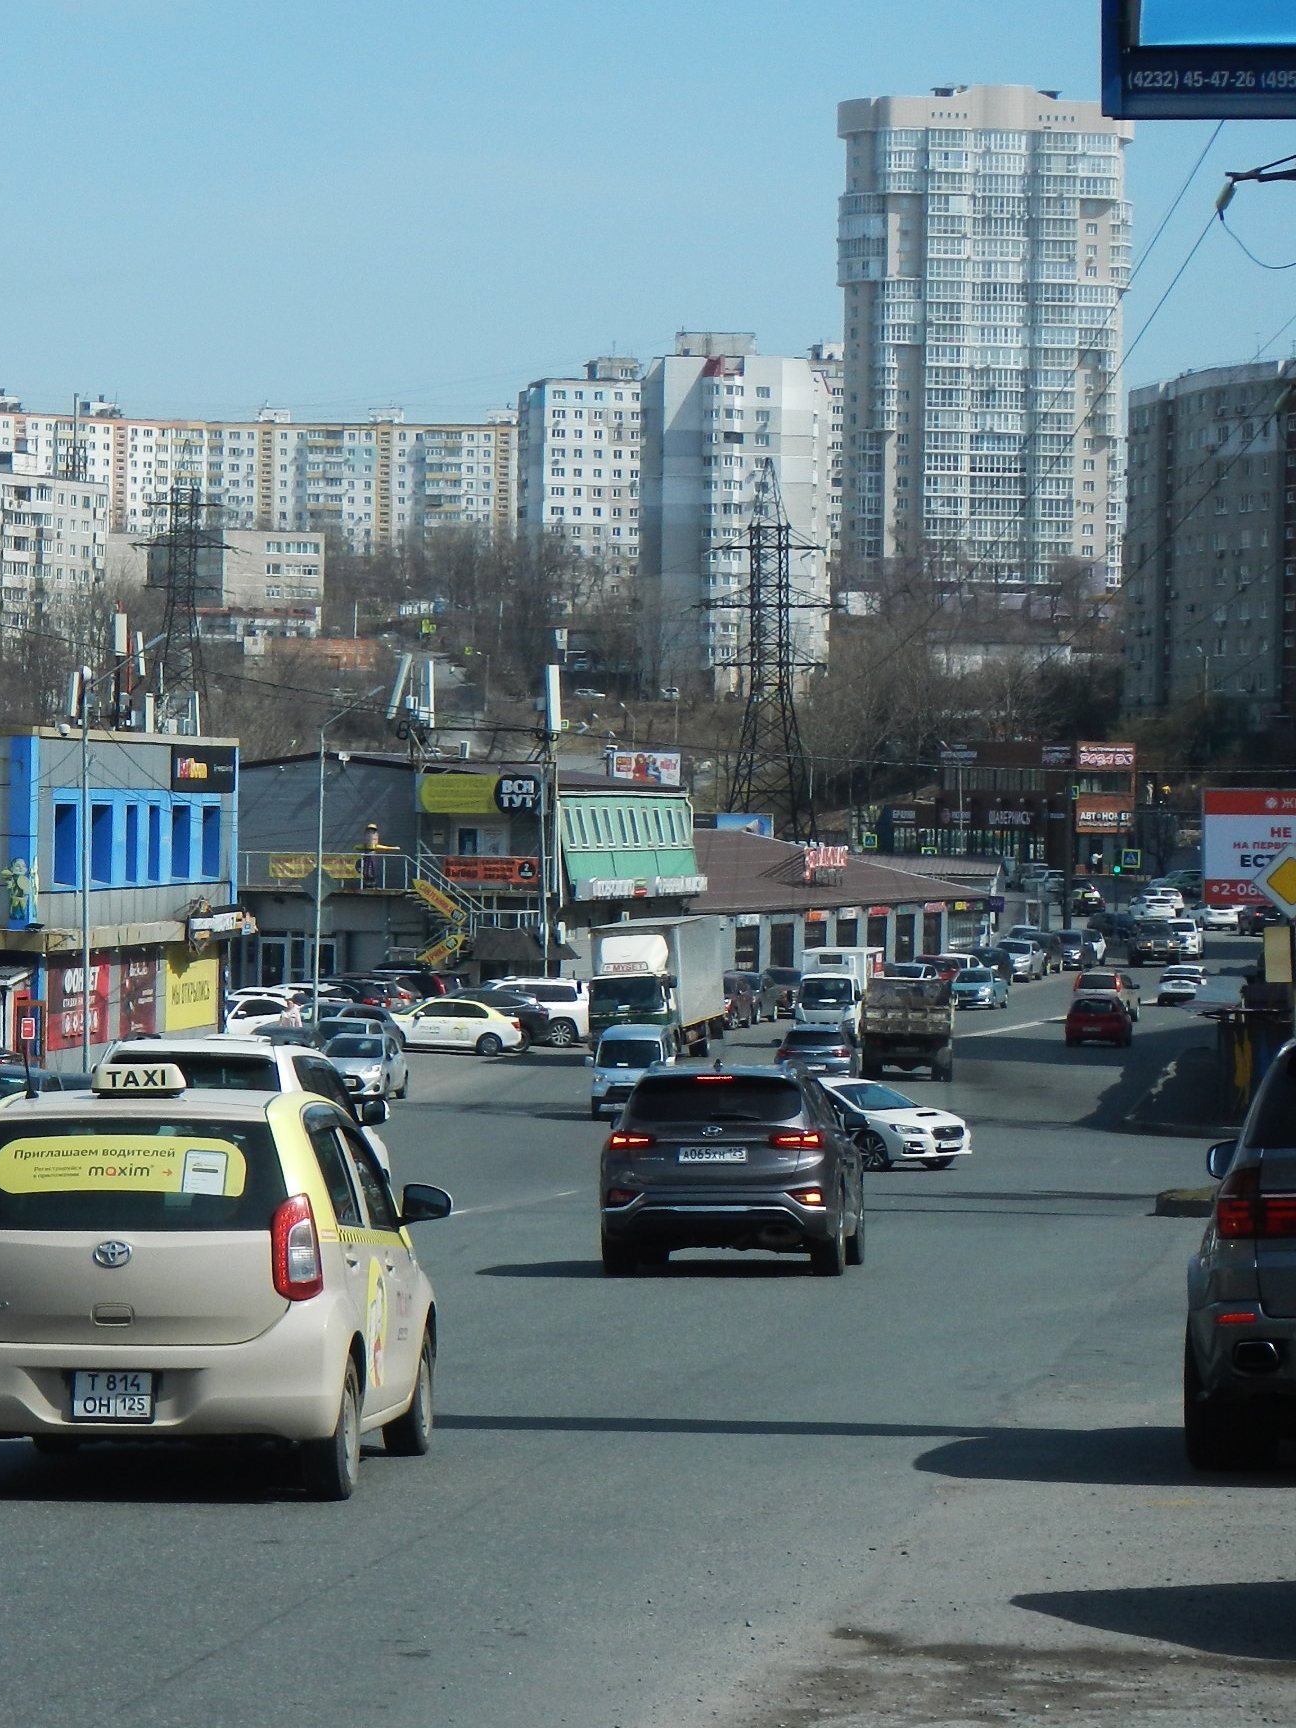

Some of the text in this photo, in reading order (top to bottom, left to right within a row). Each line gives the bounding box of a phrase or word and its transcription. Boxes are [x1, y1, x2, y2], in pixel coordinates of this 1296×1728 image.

[1128, 71, 1179, 89] (4232)
[1183, 71, 1255, 87] 45-47-26
[501, 780, 534, 793] ВСЯ
[500, 795, 534, 807] ТУТ
[1270, 827, 1292, 838] НЕ
[613, 964, 643, 972] MYSET
[65, 967, 99, 993] ФОНЕТ
[106, 1069, 166, 1088] TAXI
[14, 1147, 175, 1160] Приглашаем водителей
[88, 1163, 150, 1176] maxim
[88, 1374, 141, 1391] Т 814
[83, 1396, 145, 1414] ОН 125
